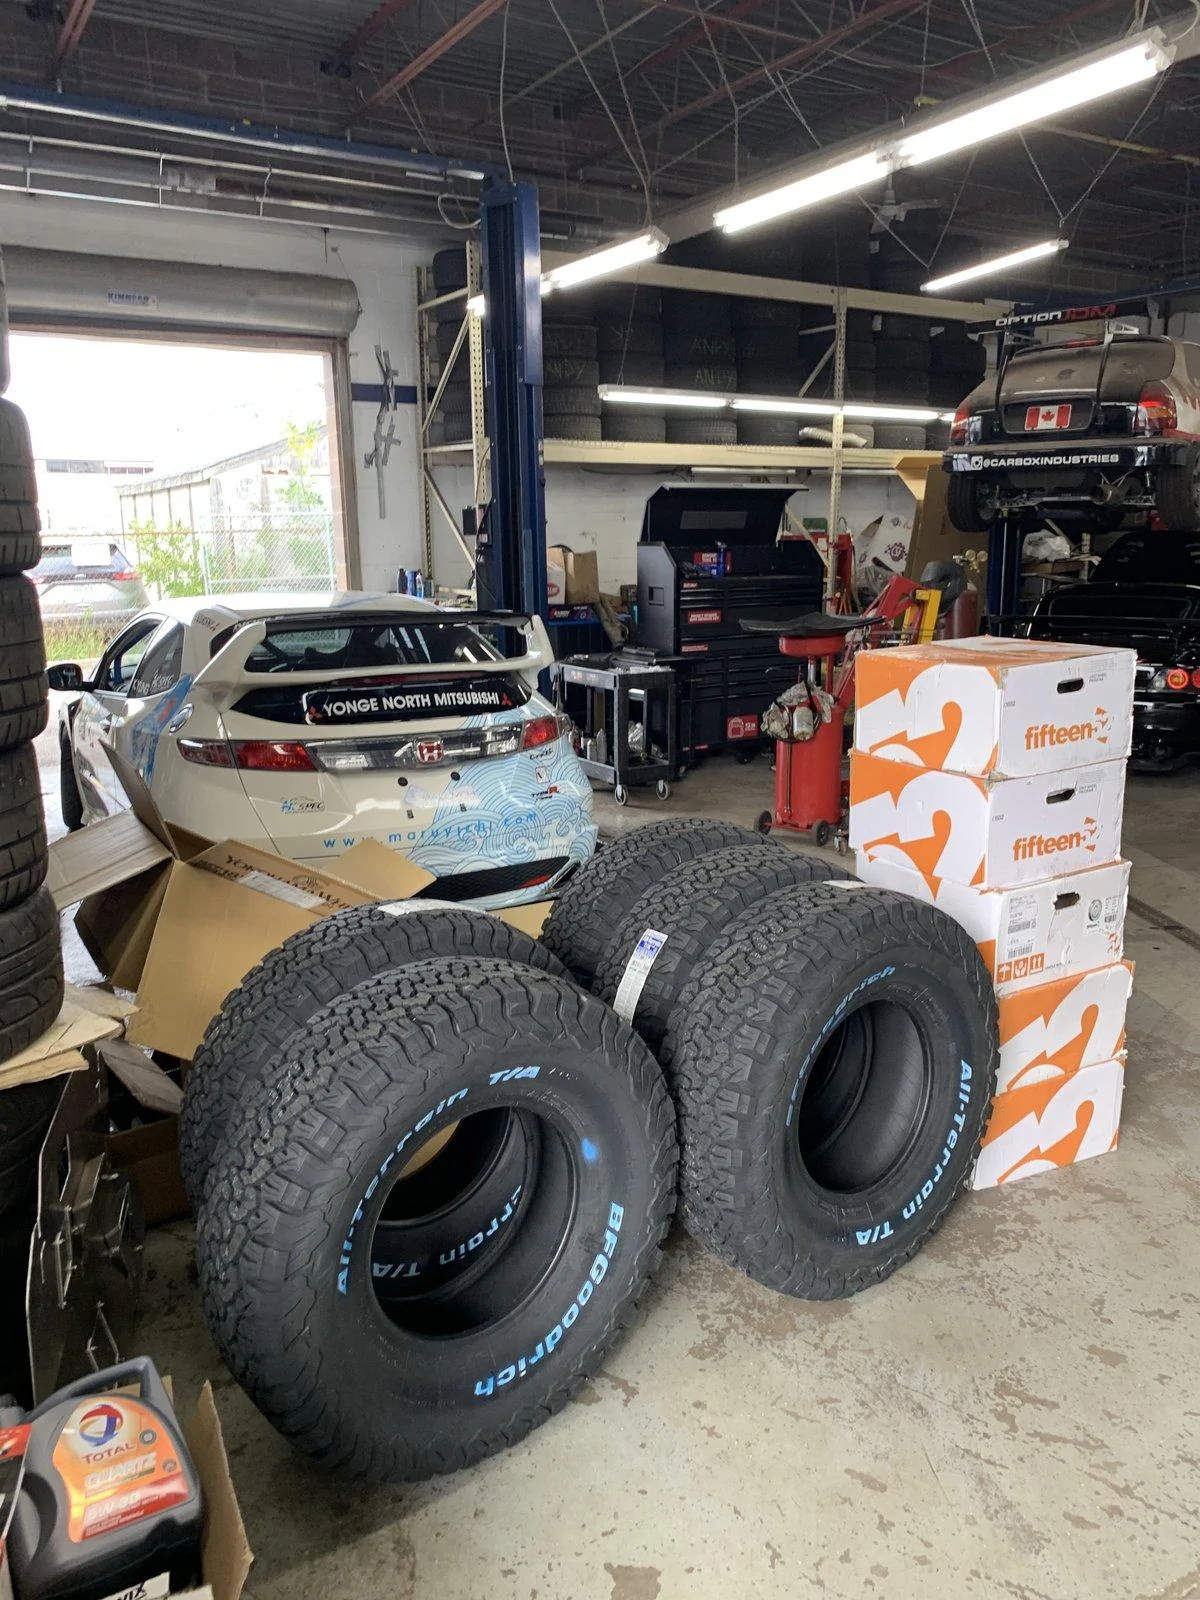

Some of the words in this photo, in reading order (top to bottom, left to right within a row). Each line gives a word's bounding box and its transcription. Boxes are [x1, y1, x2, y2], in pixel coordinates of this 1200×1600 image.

[983, 453, 1120, 469] @CARBOXINDUSTRIES
[324, 697, 380, 717] YONGE
[382, 693, 431, 709] NORTH
[433, 691, 500, 707] MITSUBISHI
[904, 1059, 973, 1219] All-Terrain
[337, 1087, 469, 1295] All-Terrain
[489, 1065, 541, 1086] T/A
[856, 1221, 894, 1246] T/A
[474, 1202, 625, 1396] BFGoodrich
[82, 1442, 135, 1465] TOTAL
